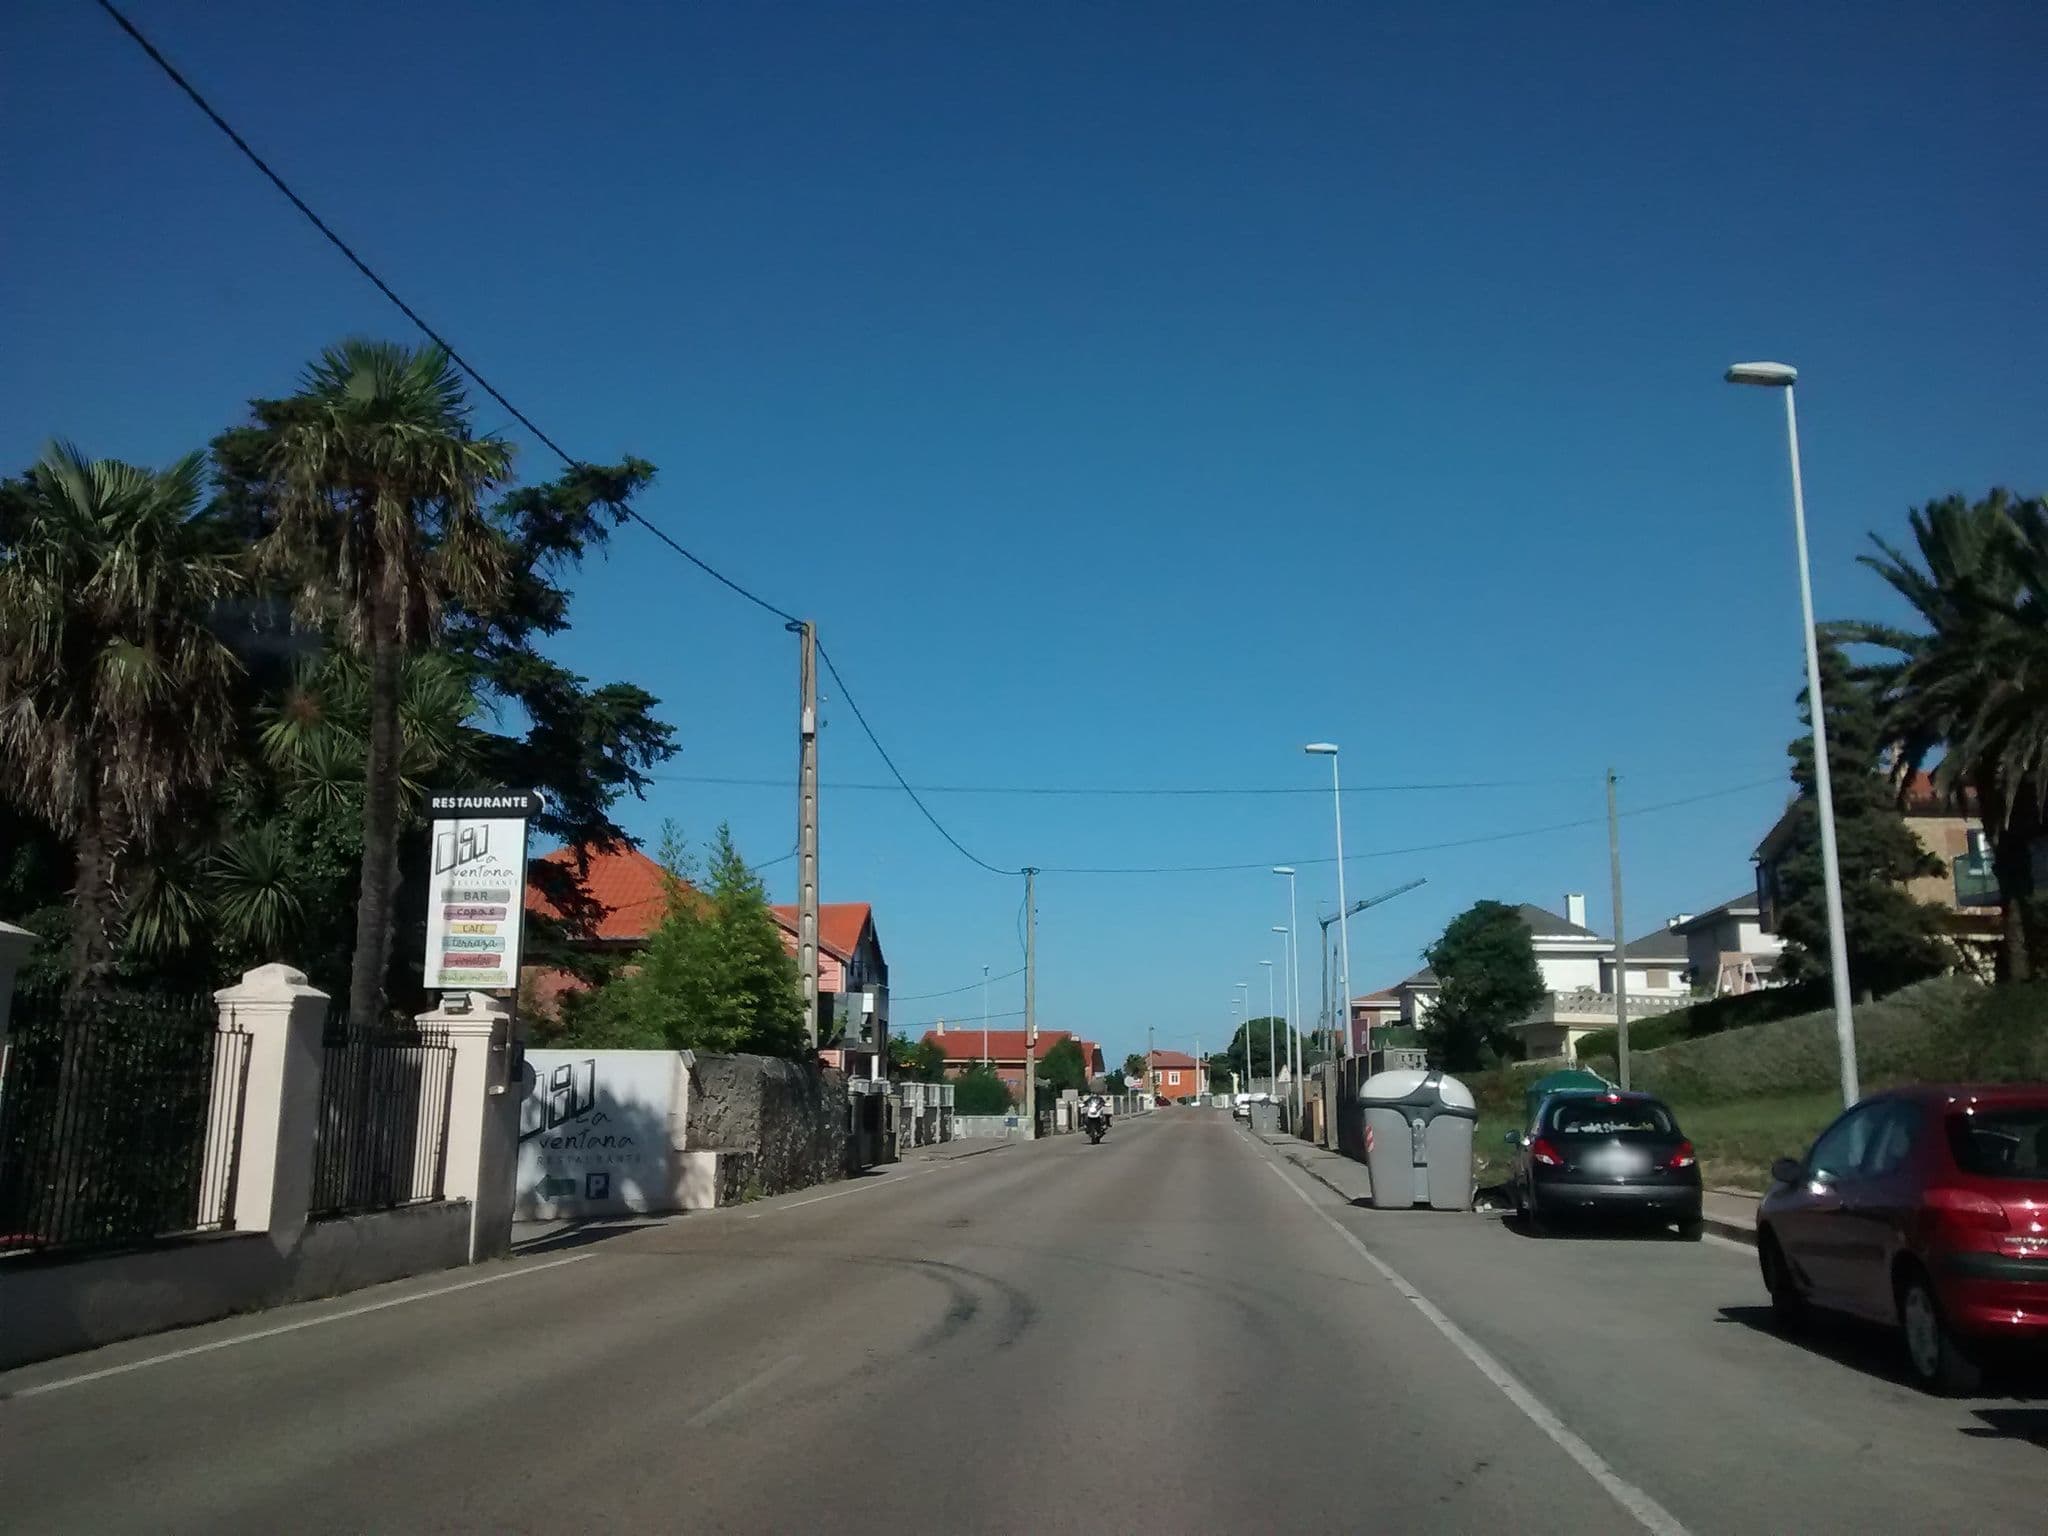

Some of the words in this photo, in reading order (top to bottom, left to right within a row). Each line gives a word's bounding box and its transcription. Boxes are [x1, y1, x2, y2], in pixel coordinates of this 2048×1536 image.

[432, 796, 528, 808] RESTAURANTE
[463, 891, 489, 901] BAR
[456, 907, 495, 919] copas
[451, 937, 498, 950] terraza
[539, 1129, 634, 1150] ventana
